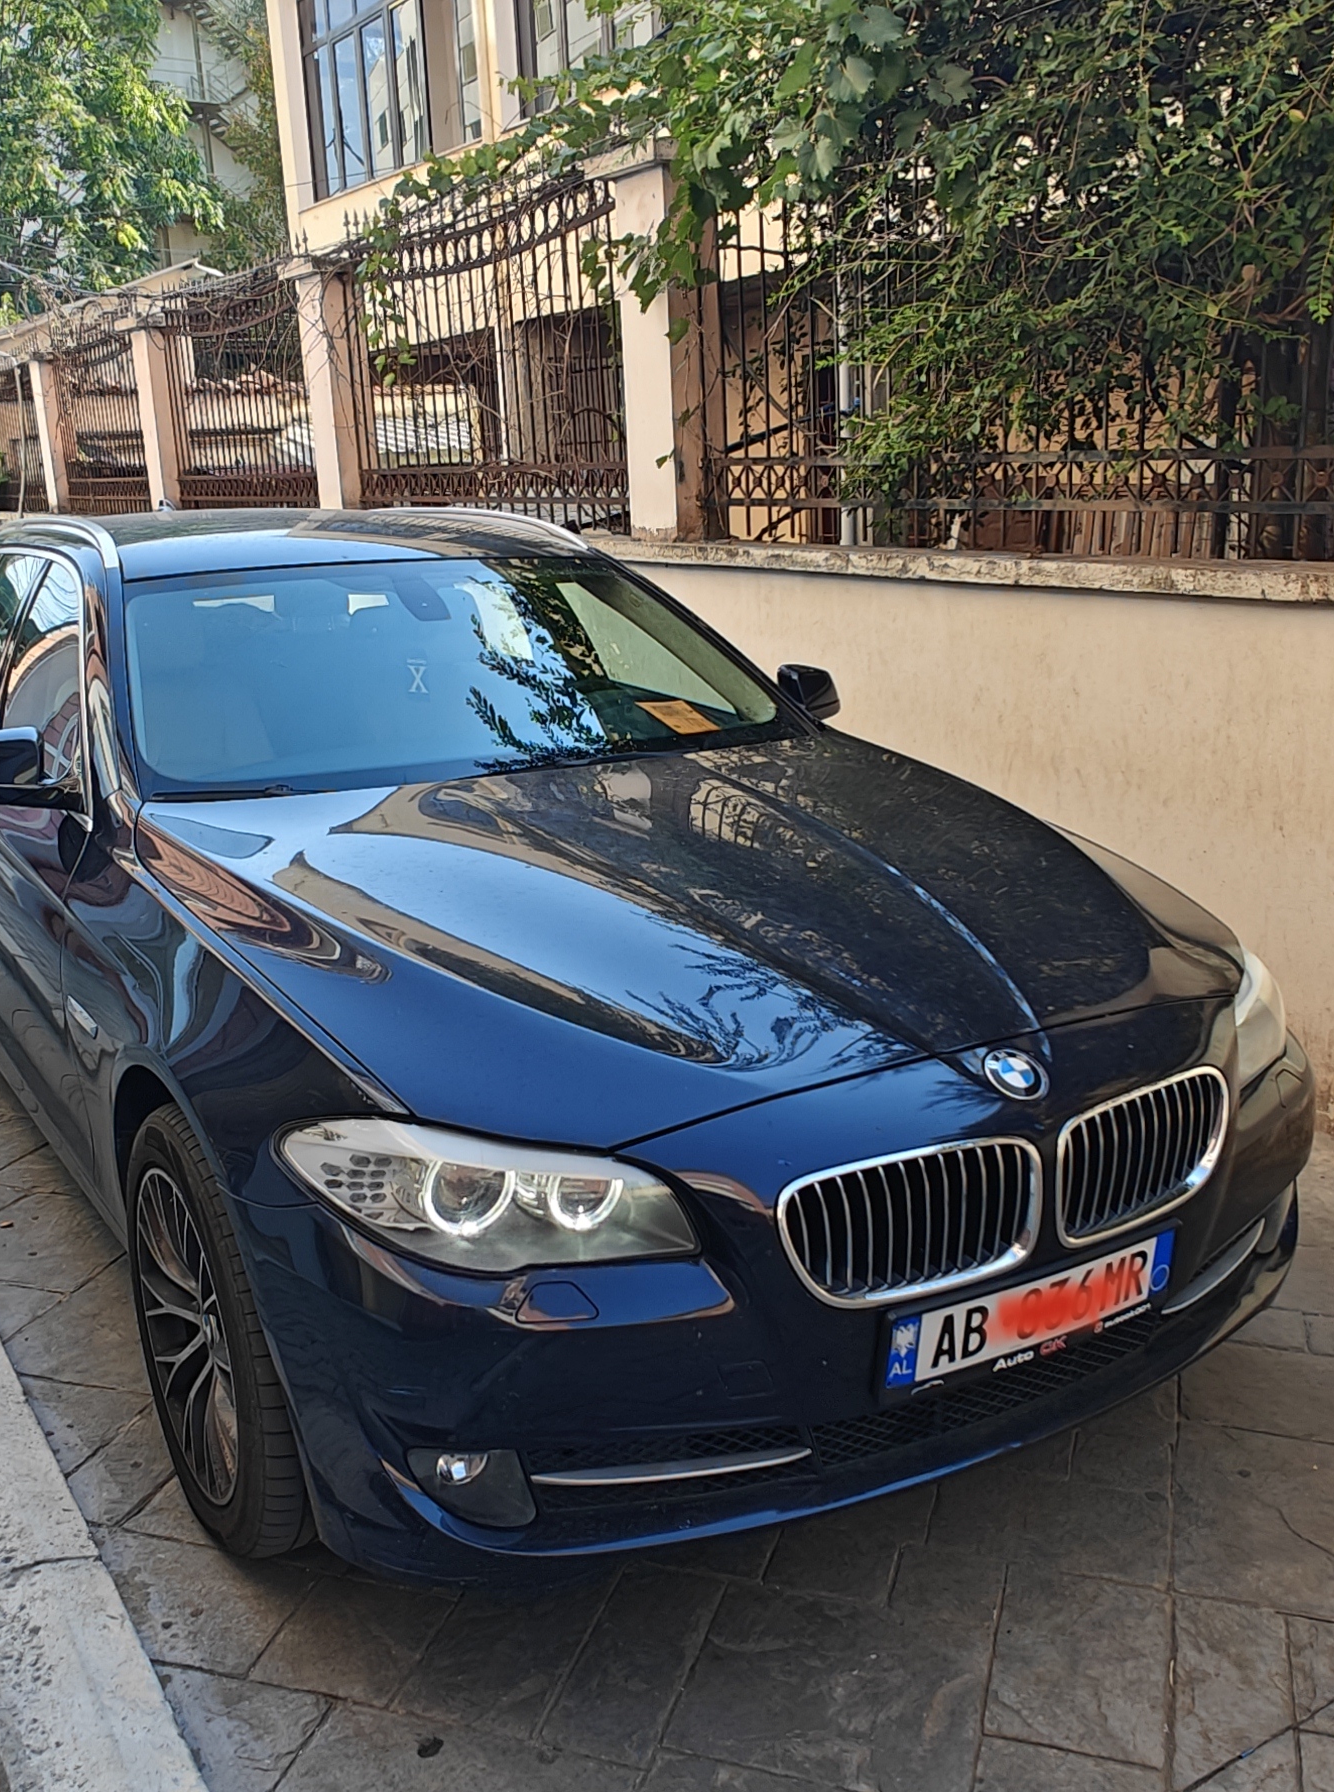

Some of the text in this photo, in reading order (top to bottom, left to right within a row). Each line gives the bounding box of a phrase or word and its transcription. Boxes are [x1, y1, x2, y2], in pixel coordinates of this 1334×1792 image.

[930, 1304, 989, 1369] AB
[1099, 1249, 1148, 1312] MR
[888, 1361, 913, 1378] AL
[991, 1350, 1035, 1372] Auto
